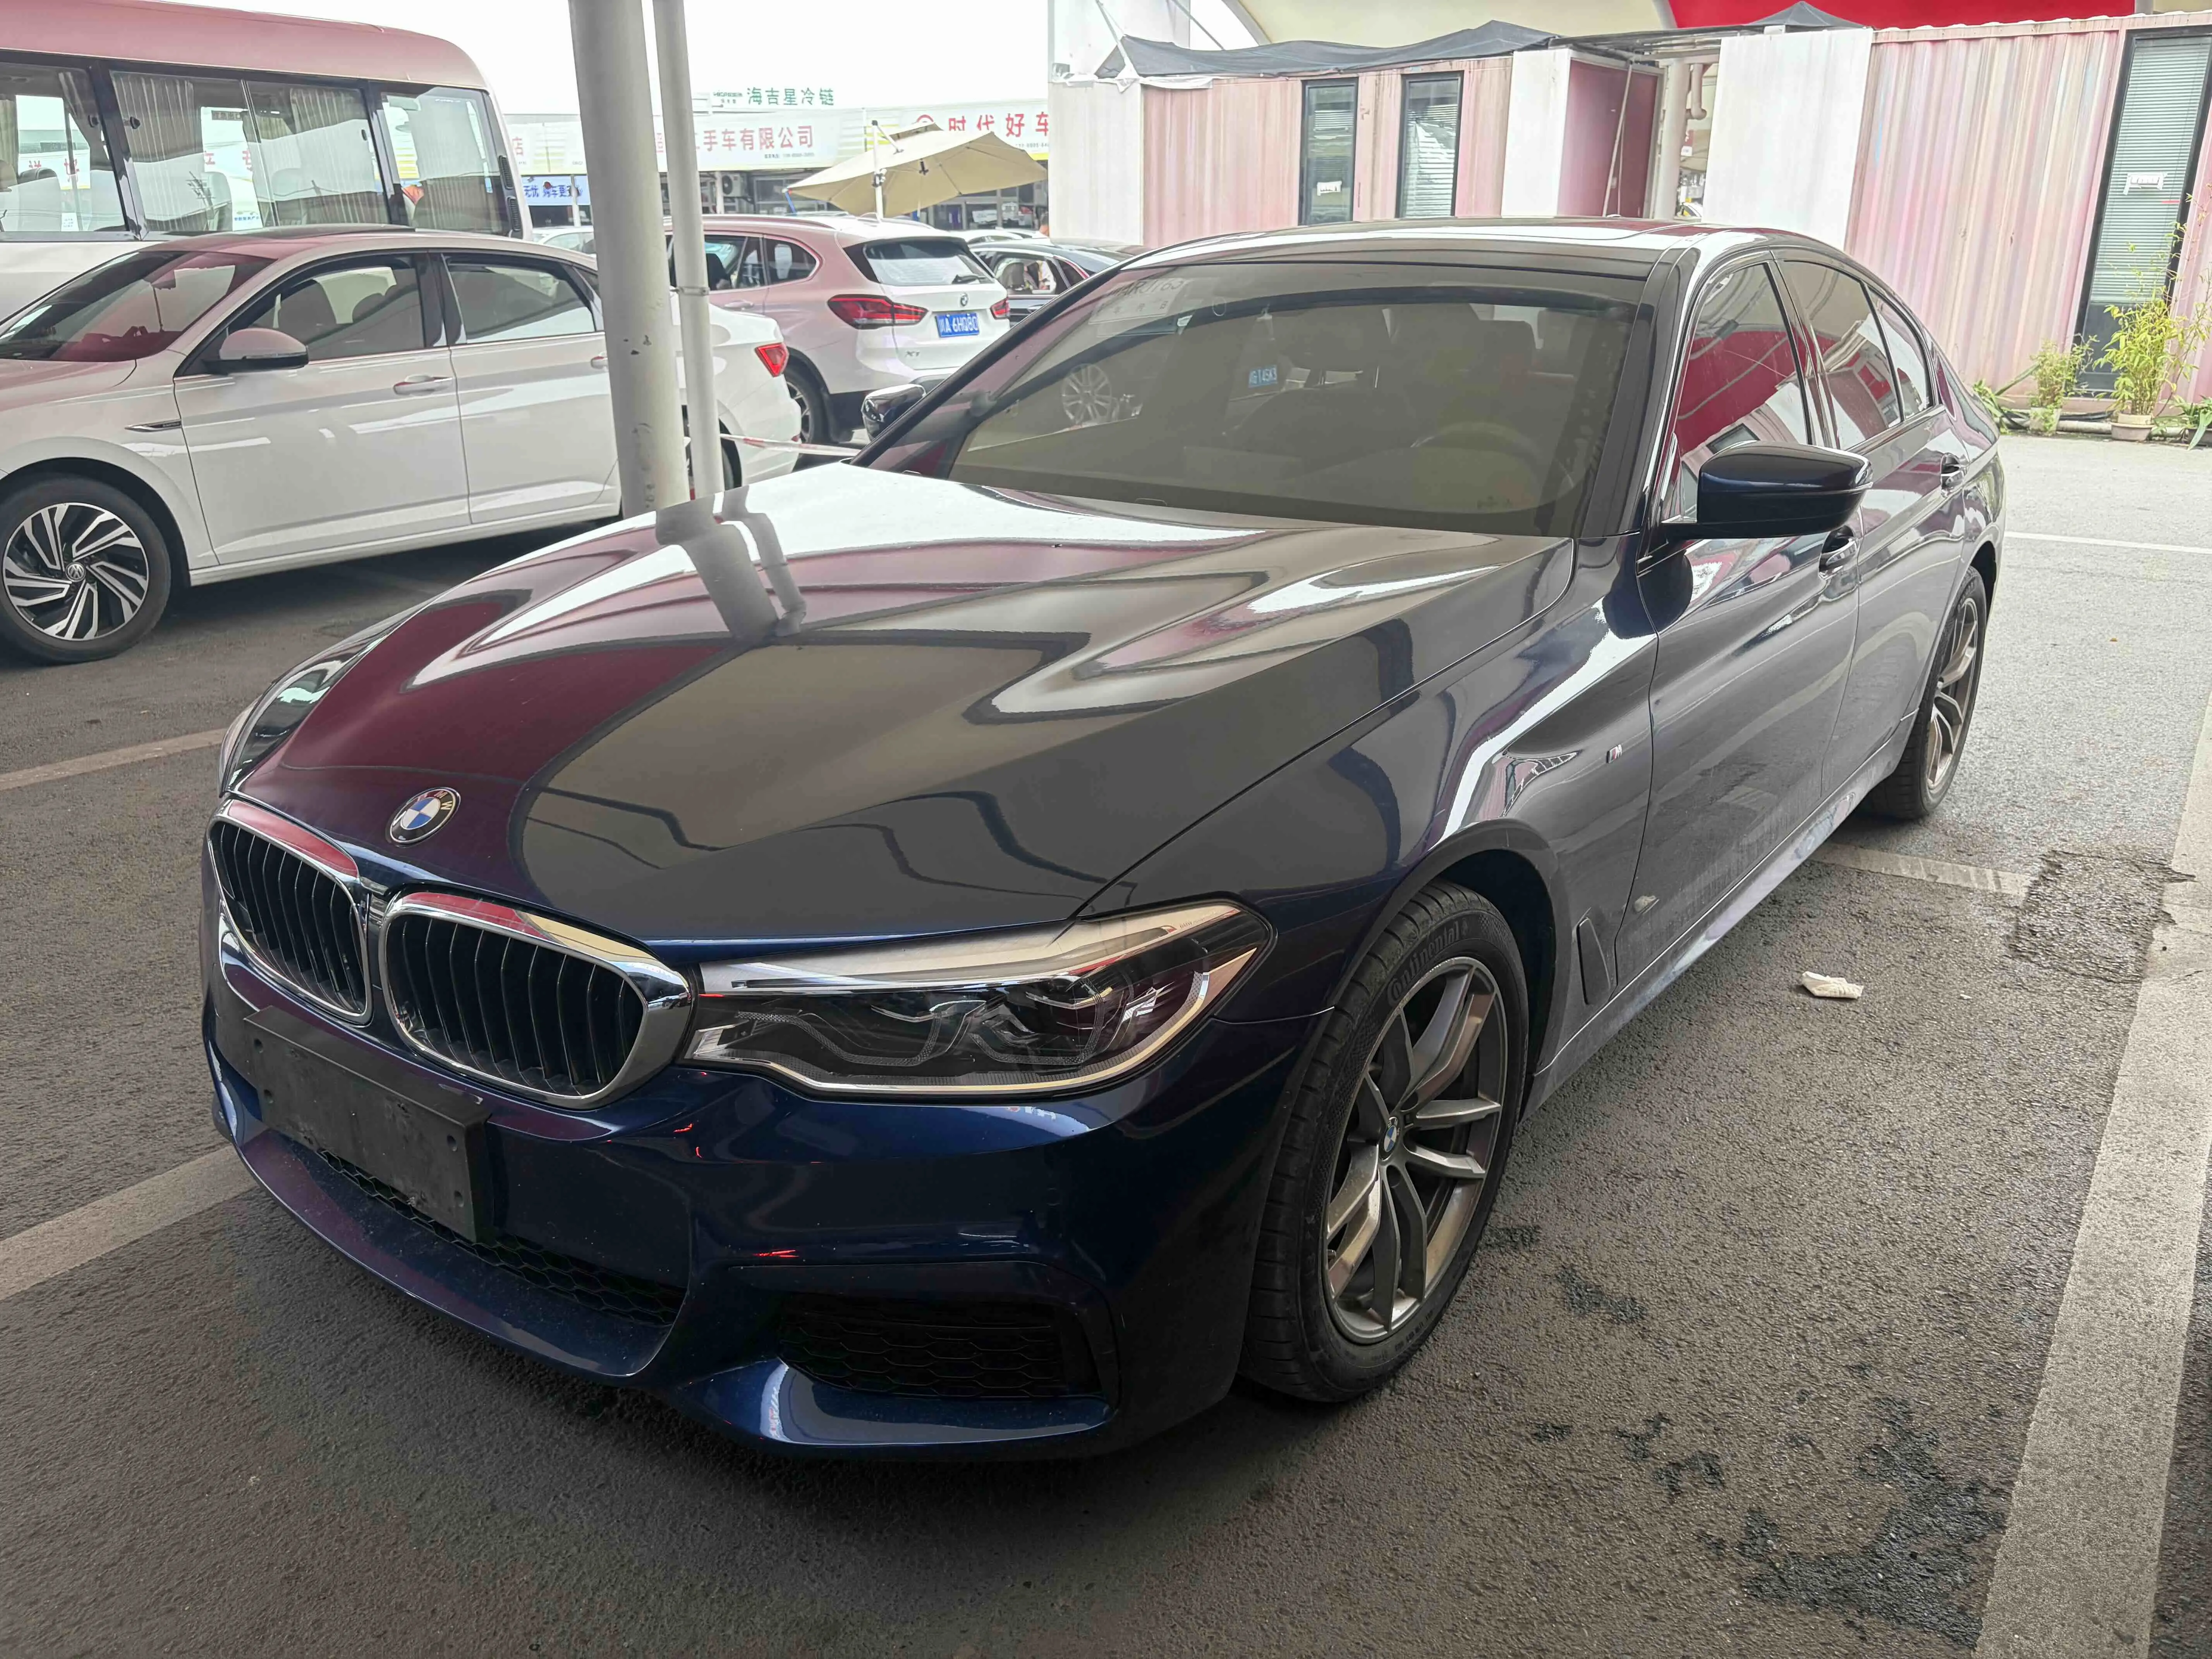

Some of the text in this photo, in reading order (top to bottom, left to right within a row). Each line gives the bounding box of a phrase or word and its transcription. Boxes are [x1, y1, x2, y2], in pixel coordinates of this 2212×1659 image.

[948, 112, 1049, 137] 时代好车
[695, 125, 813, 152] 手车有限公司
[1387, 920, 1459, 1005] Continental
